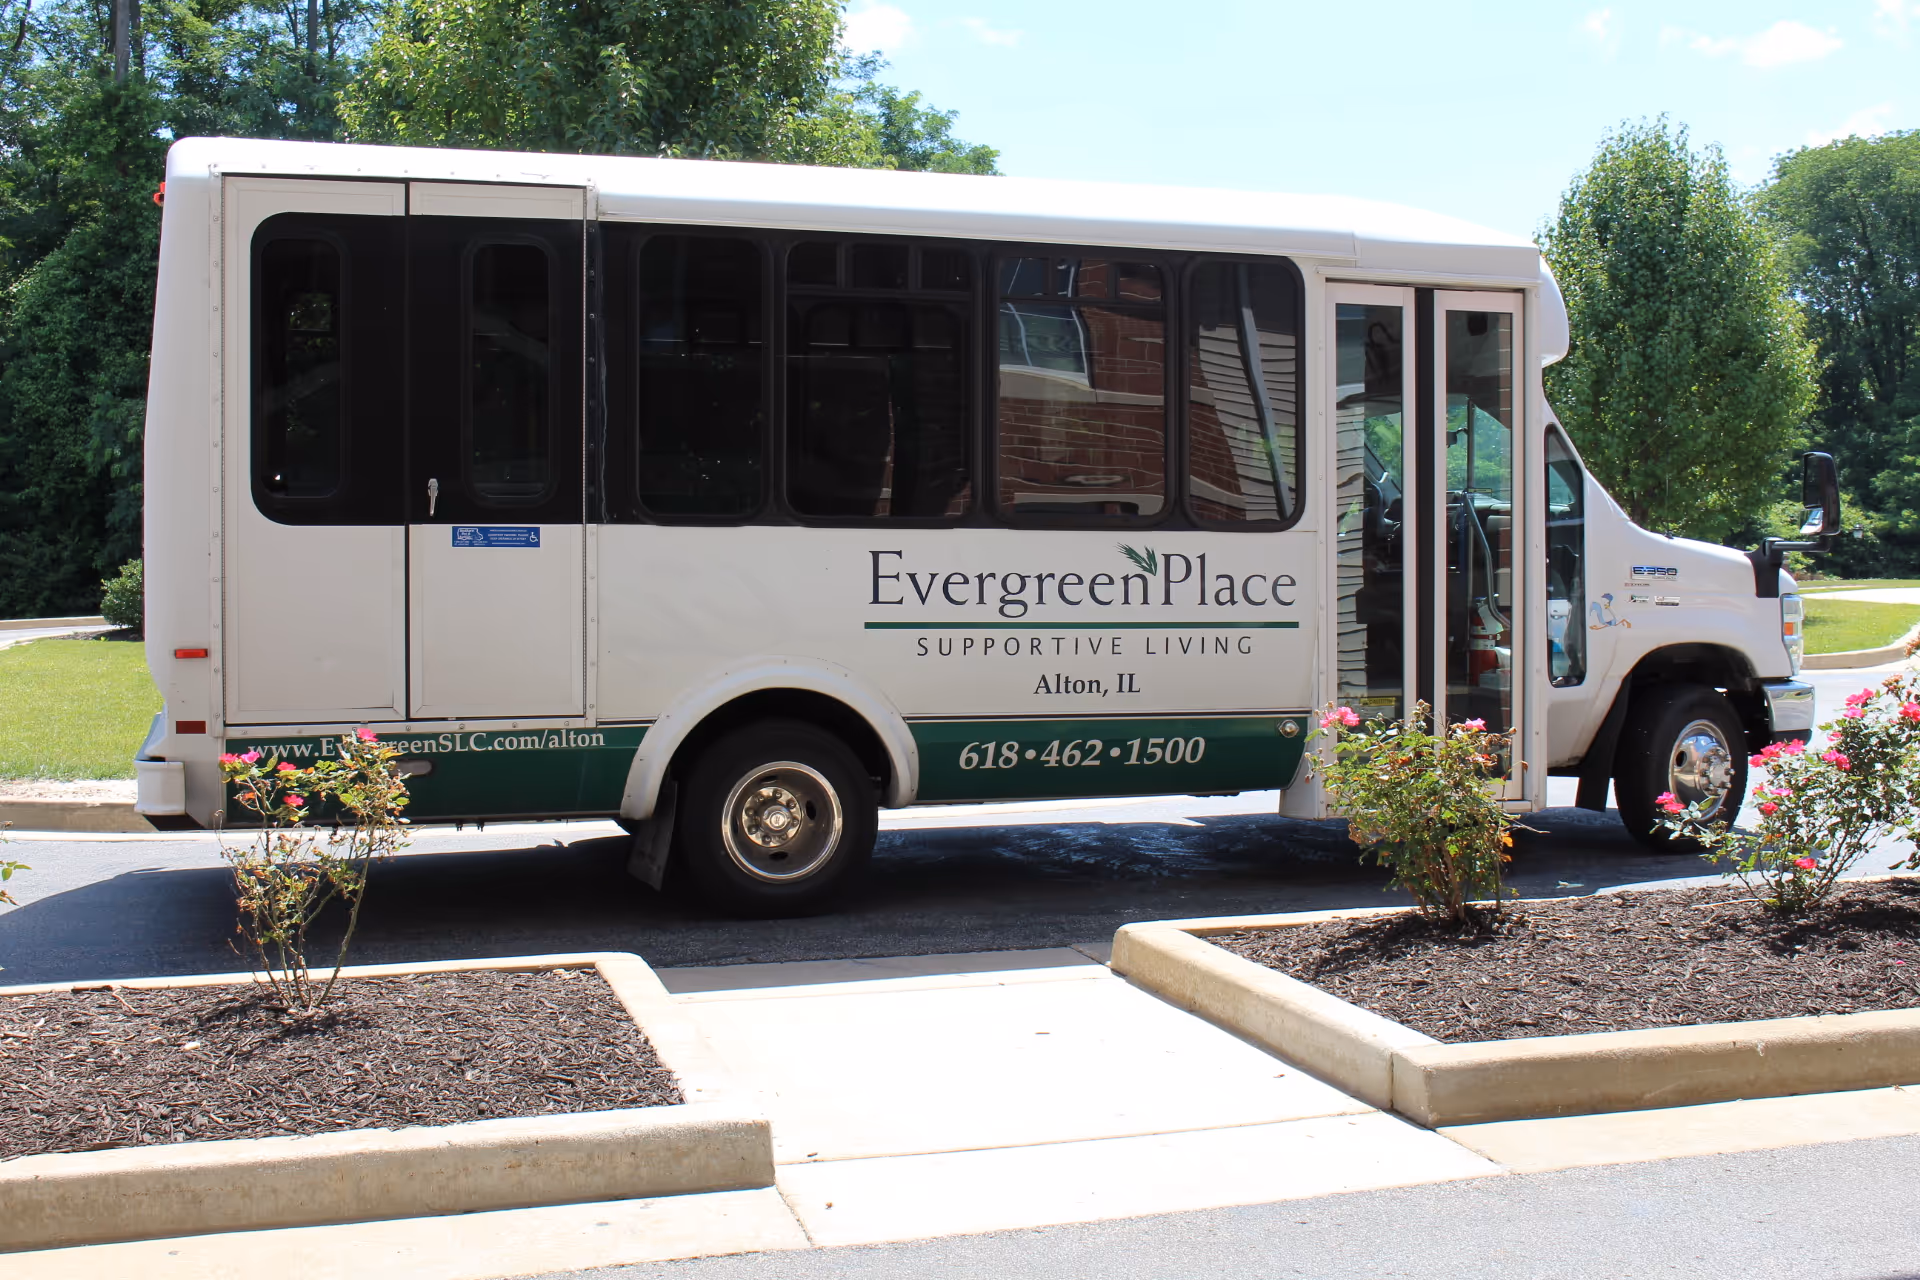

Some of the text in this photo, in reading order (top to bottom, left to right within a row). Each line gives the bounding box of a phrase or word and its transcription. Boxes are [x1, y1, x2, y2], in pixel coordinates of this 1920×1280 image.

[916, 635, 1254, 656] SUPPORTIVE LIVING
[1033, 672, 1142, 698] Alton, IL
